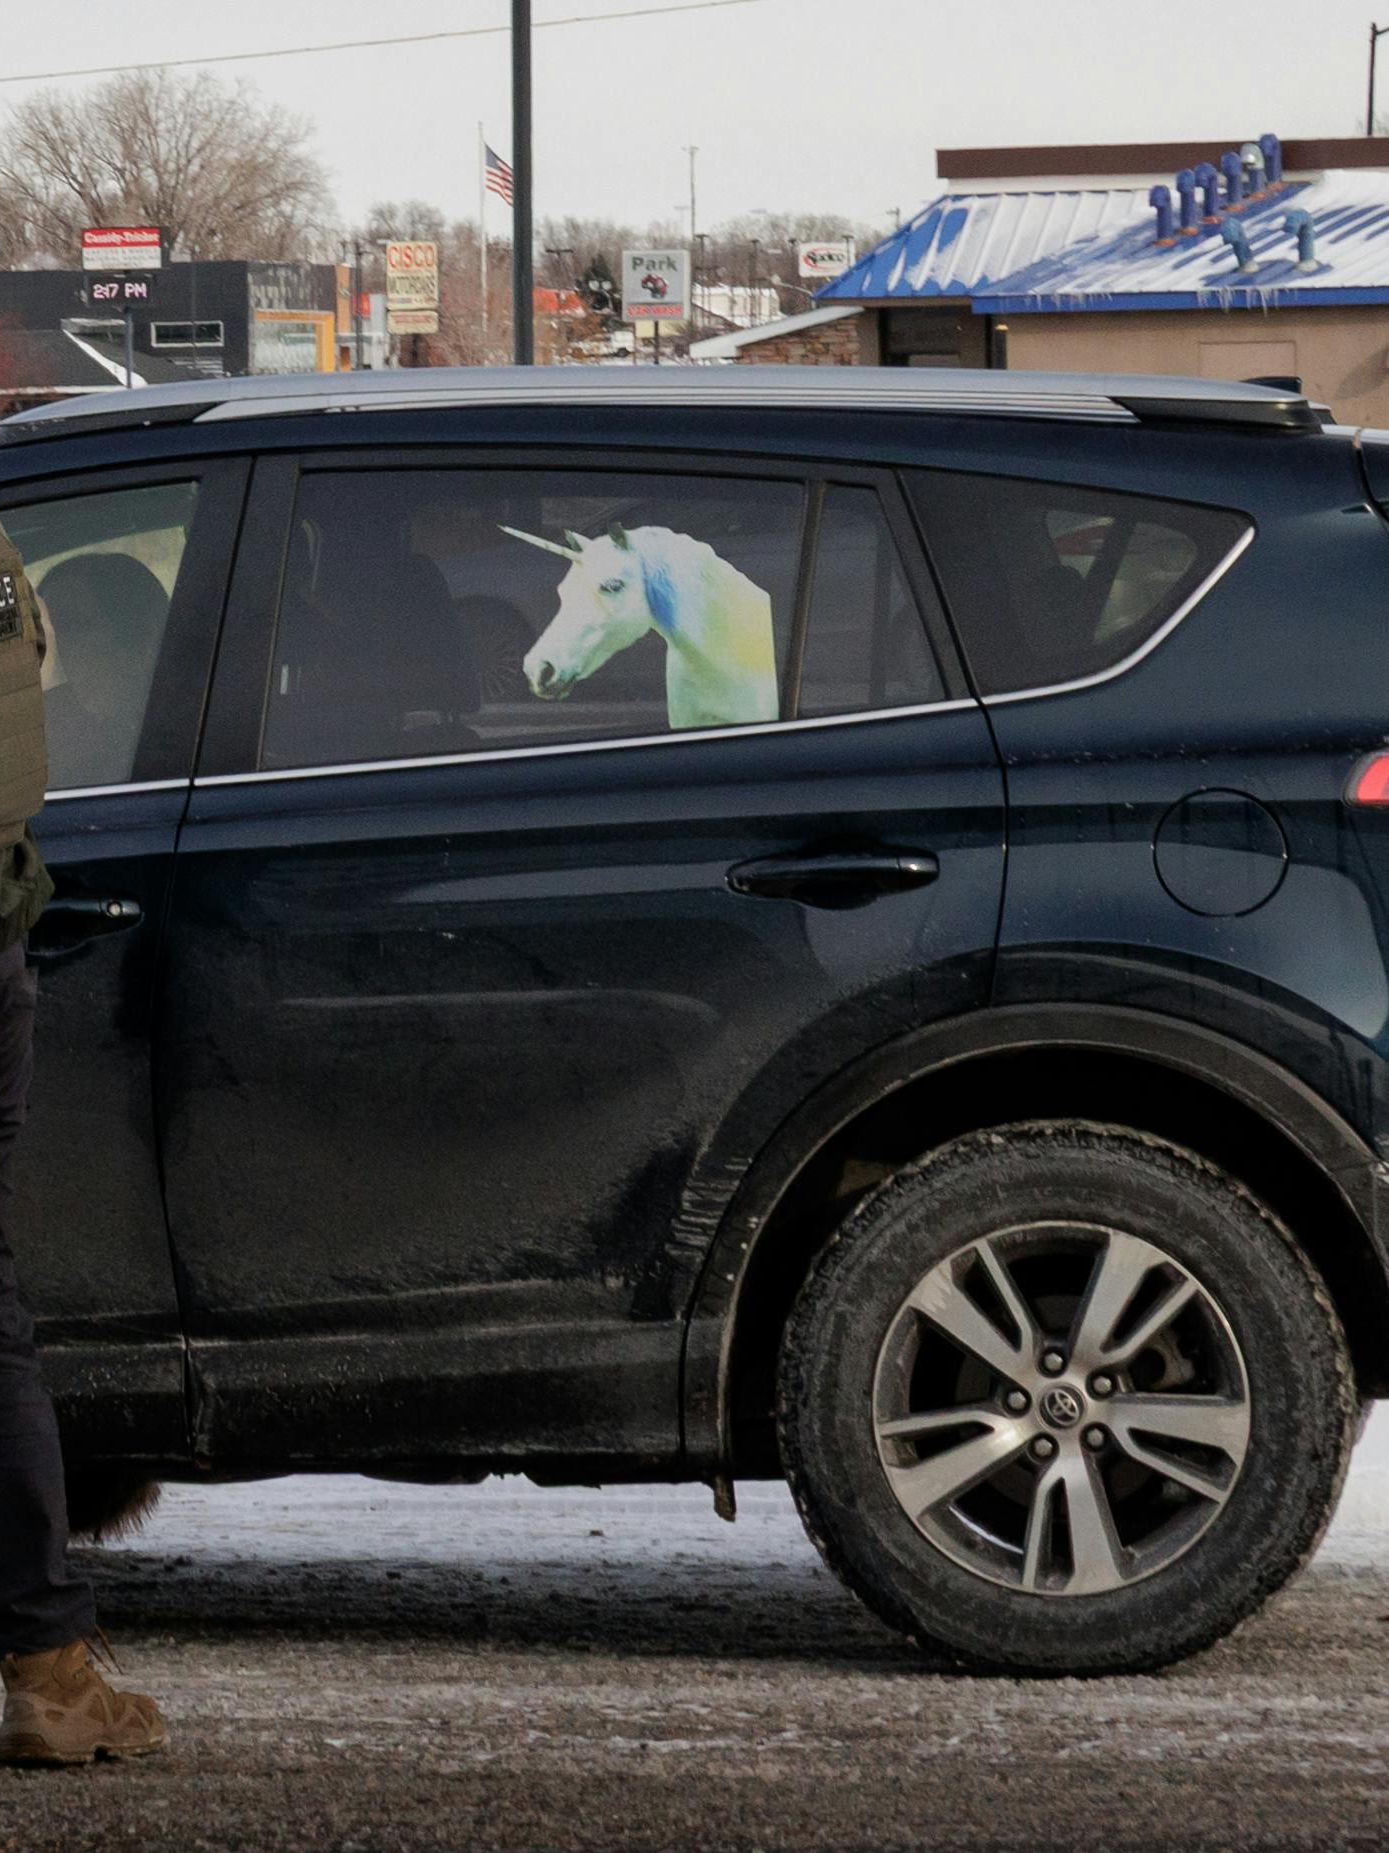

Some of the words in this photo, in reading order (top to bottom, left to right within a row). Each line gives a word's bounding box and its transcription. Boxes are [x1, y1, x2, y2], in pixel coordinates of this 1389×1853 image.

[386, 244, 434, 268] CISCO
[632, 255, 677, 272] Park
[124, 283, 147, 298] PM
